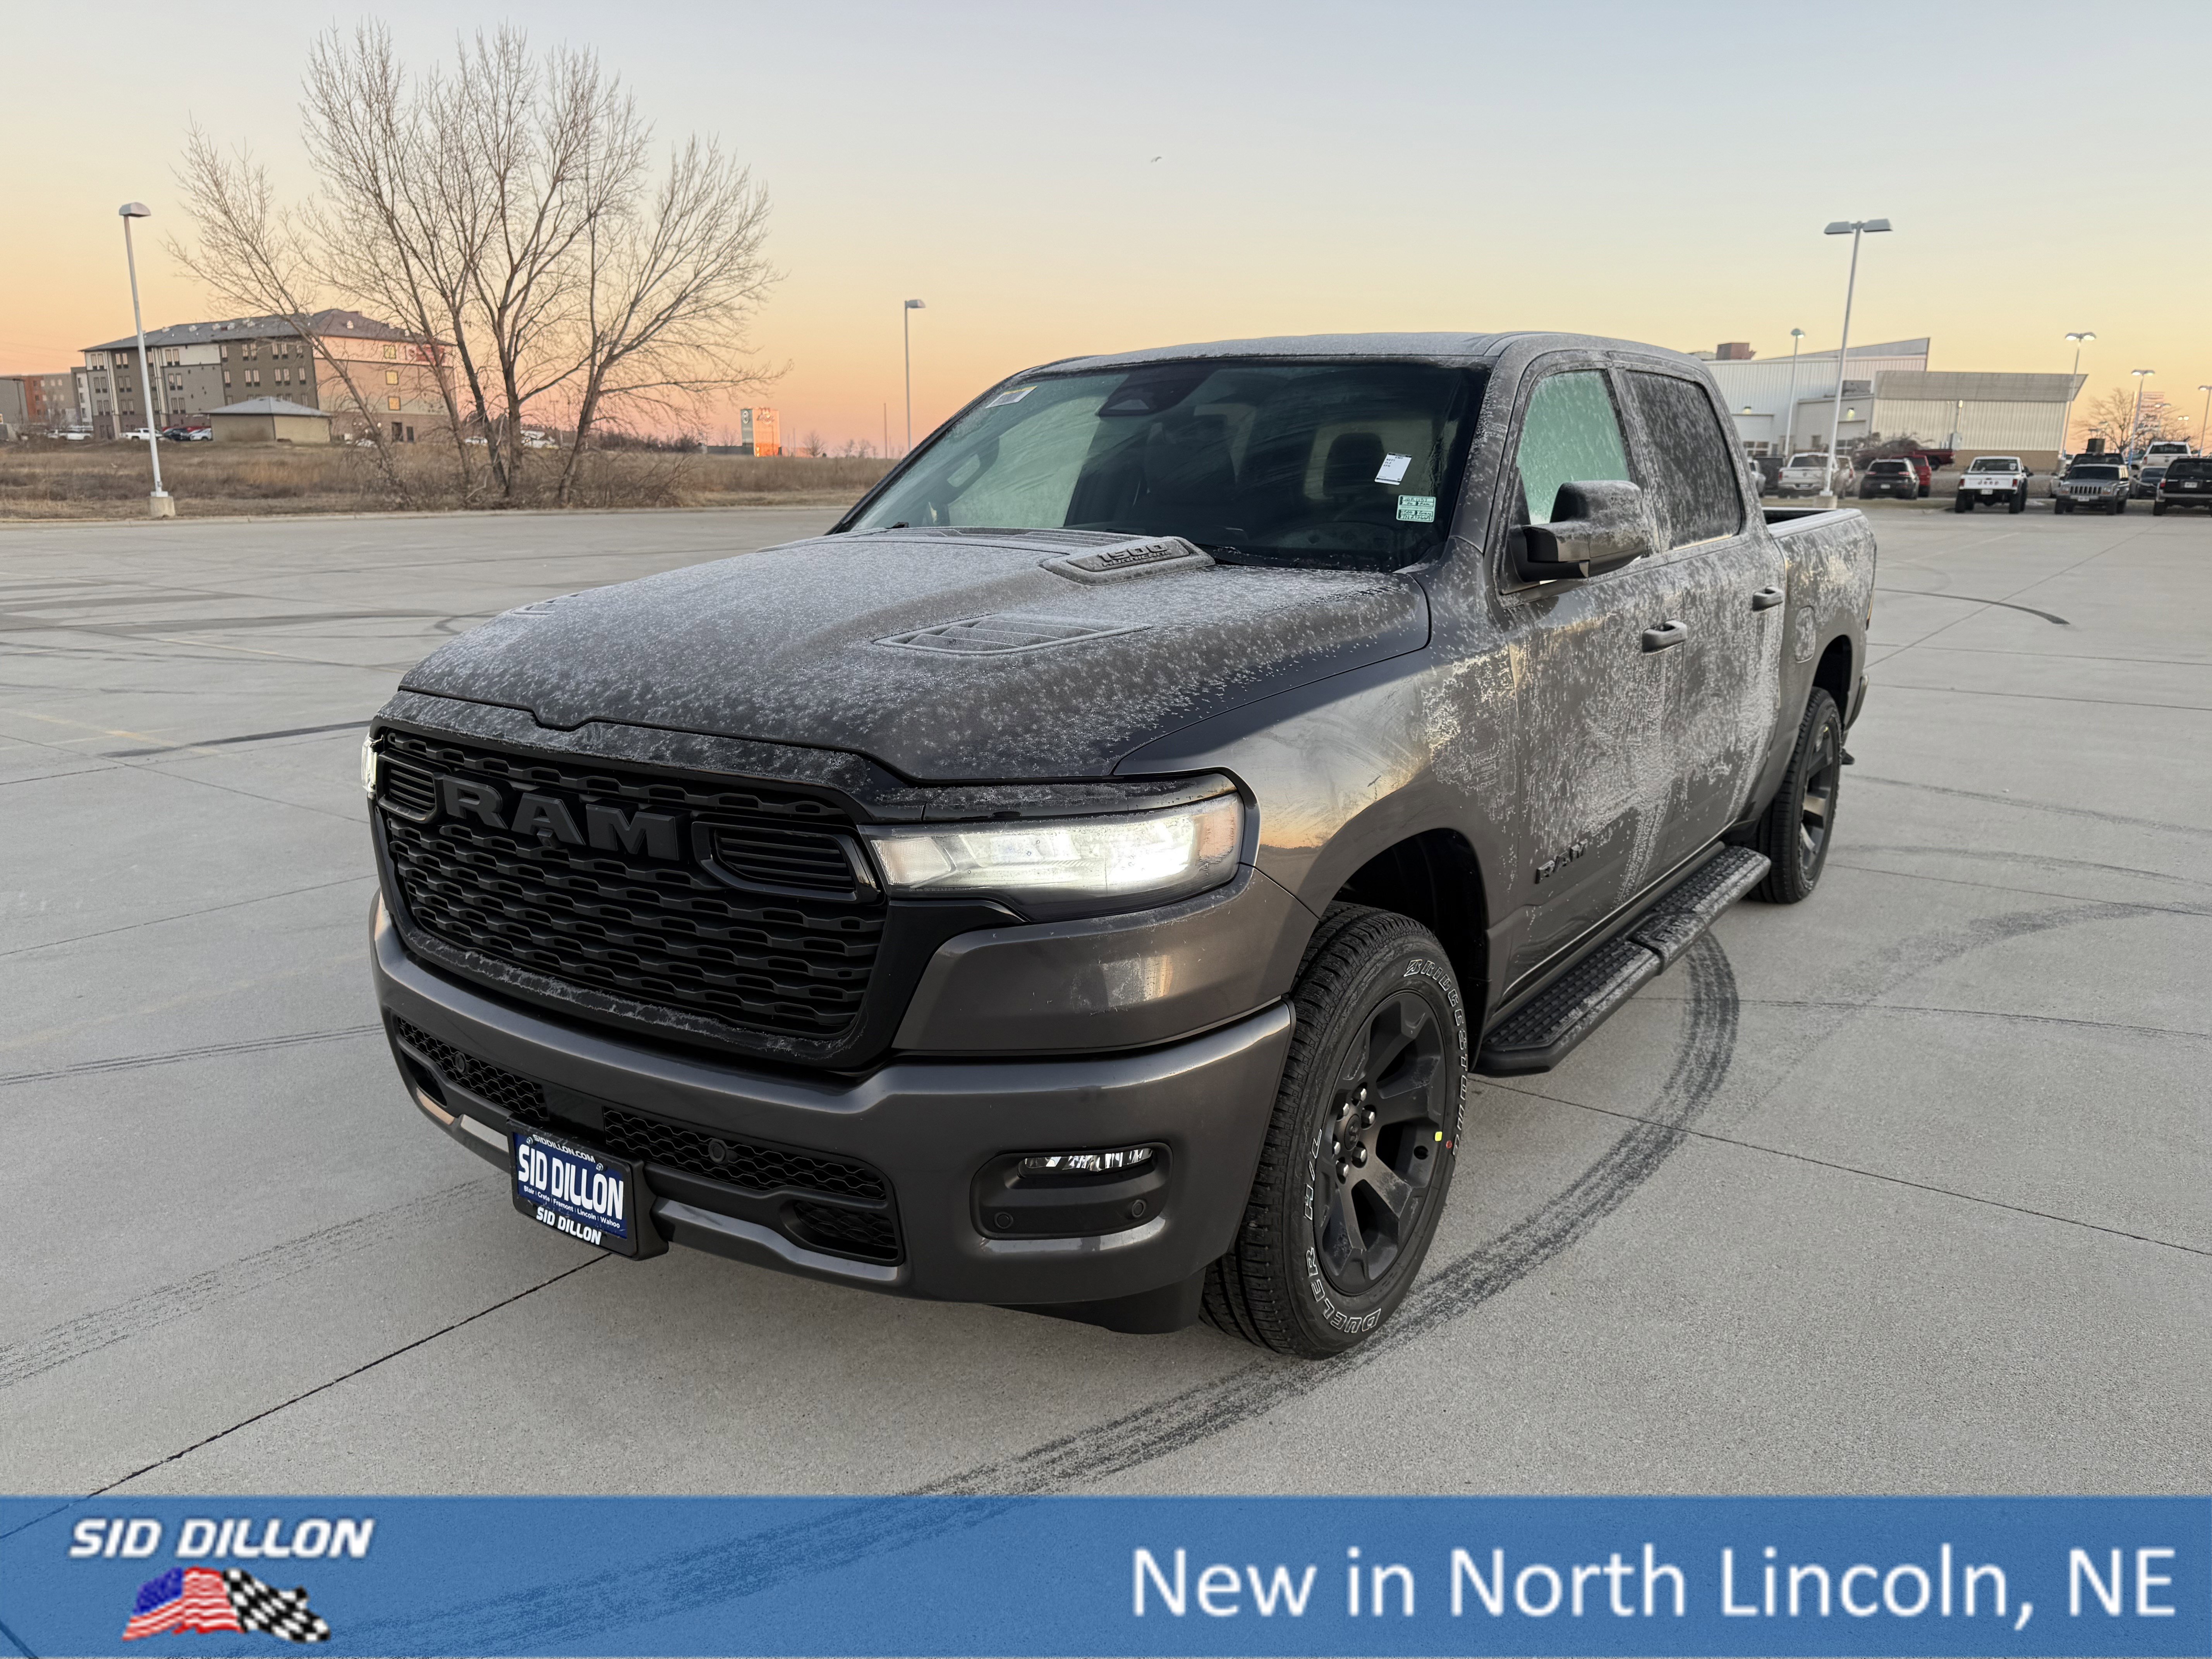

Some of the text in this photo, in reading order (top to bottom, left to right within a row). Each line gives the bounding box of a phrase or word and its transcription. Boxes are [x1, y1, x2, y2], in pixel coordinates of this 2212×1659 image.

[1097, 542, 1168, 562] 1500
[444, 775, 680, 860] RAM
[1534, 839, 1588, 884] RAM
[1403, 959, 1468, 1156] BRIDGESTONE
[532, 1134, 596, 1163] SIDDILLON.COM
[518, 1144, 624, 1220] SID DILLON
[524, 1185, 620, 1228] Blair Crete Fremont Lincoln Wahoo
[536, 1206, 601, 1245] SID DILLON
[1306, 1247, 1381, 1333] DUELER
